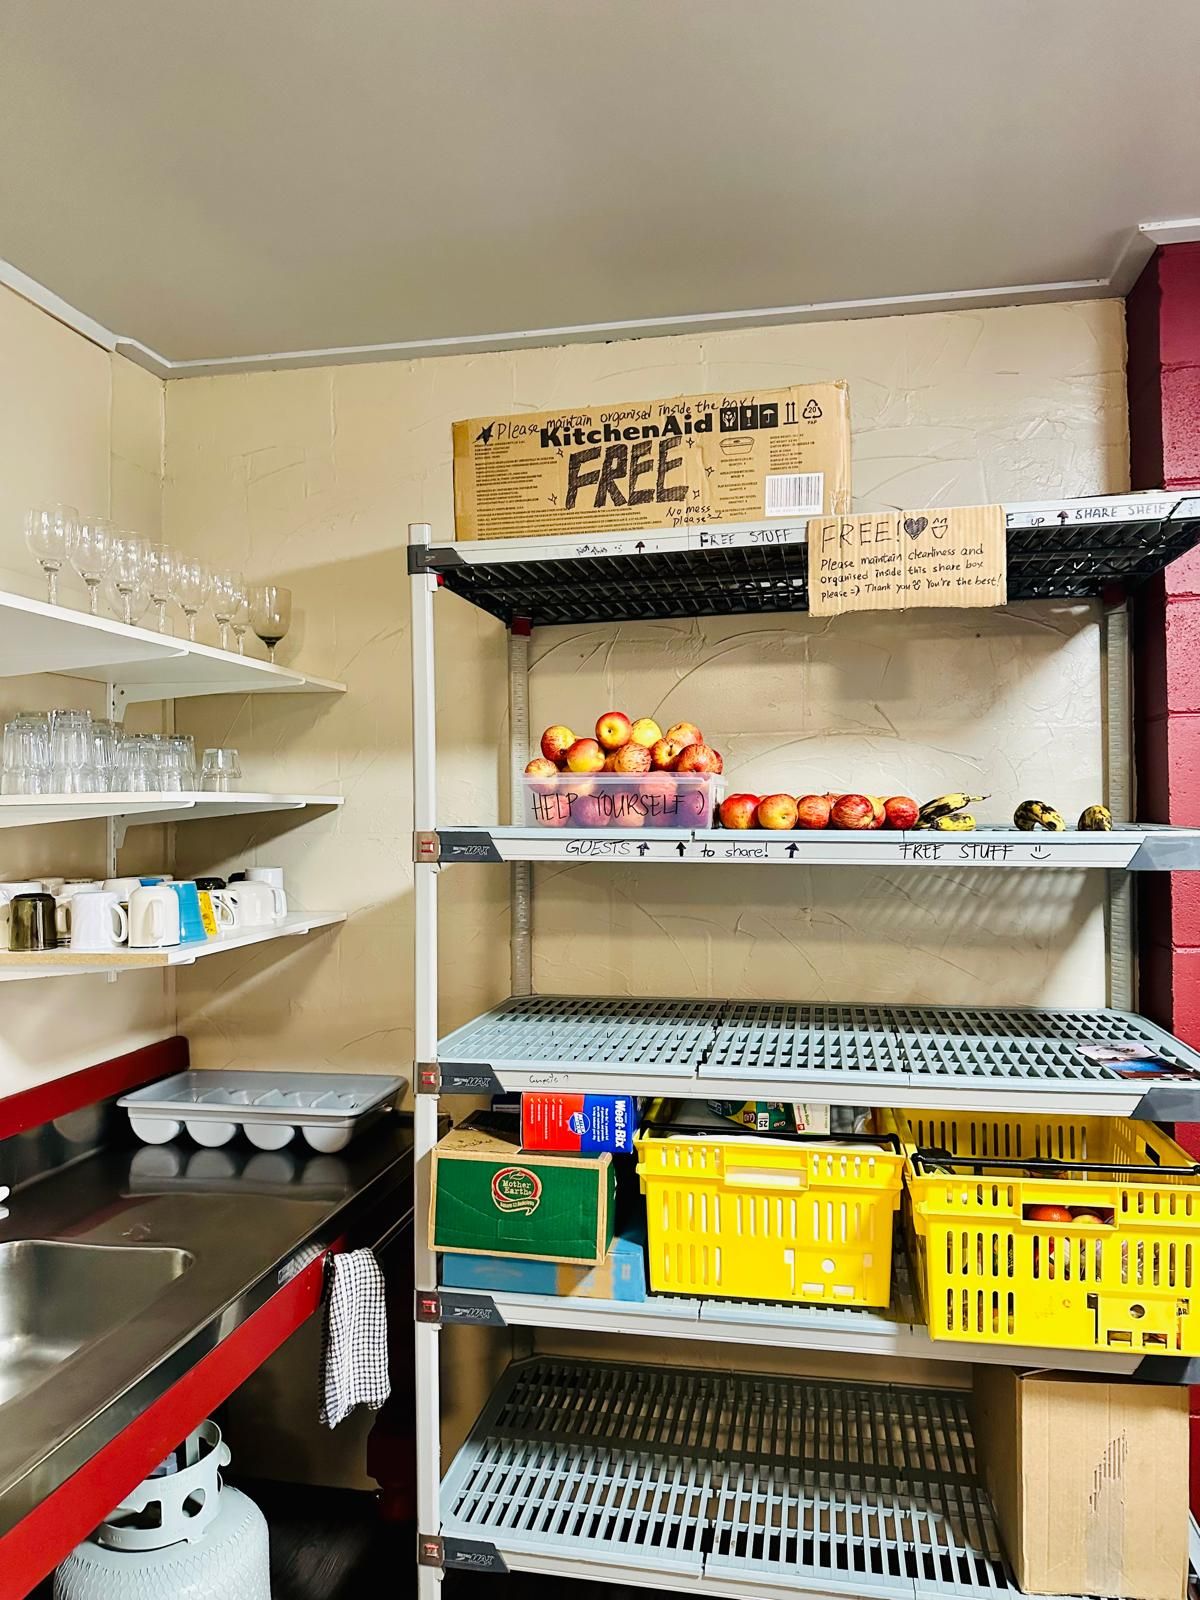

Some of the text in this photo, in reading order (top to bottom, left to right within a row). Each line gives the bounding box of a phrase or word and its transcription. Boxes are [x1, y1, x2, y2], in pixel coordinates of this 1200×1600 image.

[497, 421, 540, 440] Please
[546, 414, 593, 429] maintain
[600, 405, 652, 427] organised
[658, 402, 692, 416] inside
[695, 400, 719, 413] the
[540, 413, 713, 448] KitchenAid
[565, 435, 689, 510] FREE
[666, 506, 682, 517] No
[685, 505, 711, 514] mess
[1075, 507, 1117, 520] SHARE
[700, 529, 792, 547] FREE STUFF
[822, 520, 900, 553] FREE!
[820, 543, 984, 571] Please maintain cleanliness and
[820, 559, 984, 586] organised inside this share box
[821, 590, 848, 602] please
[864, 583, 892, 593] Thank
[896, 584, 911, 594] you
[927, 577, 951, 589] You're
[957, 576, 972, 586] the
[974, 573, 1002, 587] best!
[531, 792, 578, 820] HELP
[588, 790, 685, 818] YOURSELF
[566, 840, 631, 855] GUESTS
[701, 842, 769, 858] to share!
[899, 843, 1014, 860] FREE STUFF
[614, 1100, 626, 1149] Weet-Bix
[758, 1120, 768, 1128] 25
[502, 1180, 531, 1189] Mother
[504, 1187, 529, 1195] Earth
